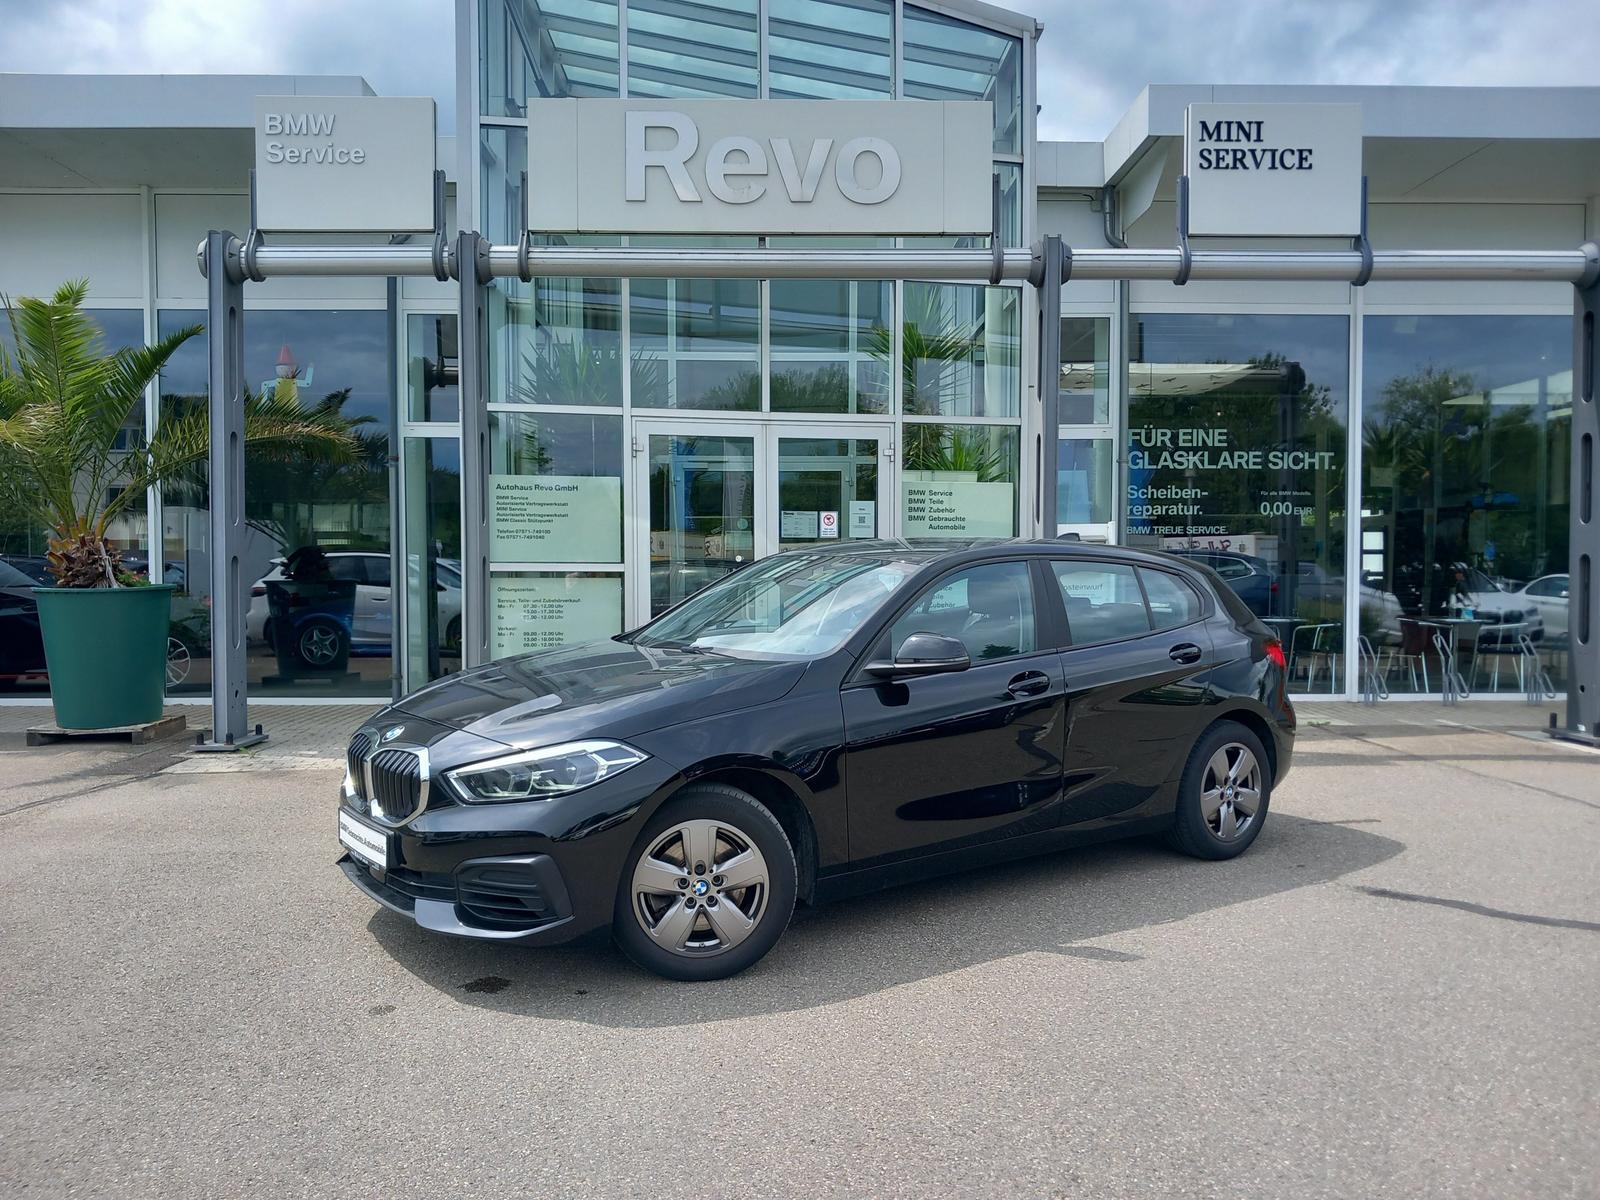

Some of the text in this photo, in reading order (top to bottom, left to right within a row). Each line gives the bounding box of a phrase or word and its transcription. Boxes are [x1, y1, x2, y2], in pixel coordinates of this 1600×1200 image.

[265, 113, 335, 136] BMW
[1199, 121, 1264, 142] MINI
[266, 142, 365, 163] Service
[625, 110, 902, 205] Revo
[1199, 148, 1313, 170] SERVICE
[1128, 425, 1227, 446] FÜR EINE
[1128, 451, 1336, 470] GLASKLARE SICHT.
[1127, 486, 1208, 498] Scheiben-
[1127, 503, 1203, 518] reparatur.
[1260, 501, 1292, 518] 0,00
[1127, 526, 1228, 534] BMW TREUE SERVICE.
